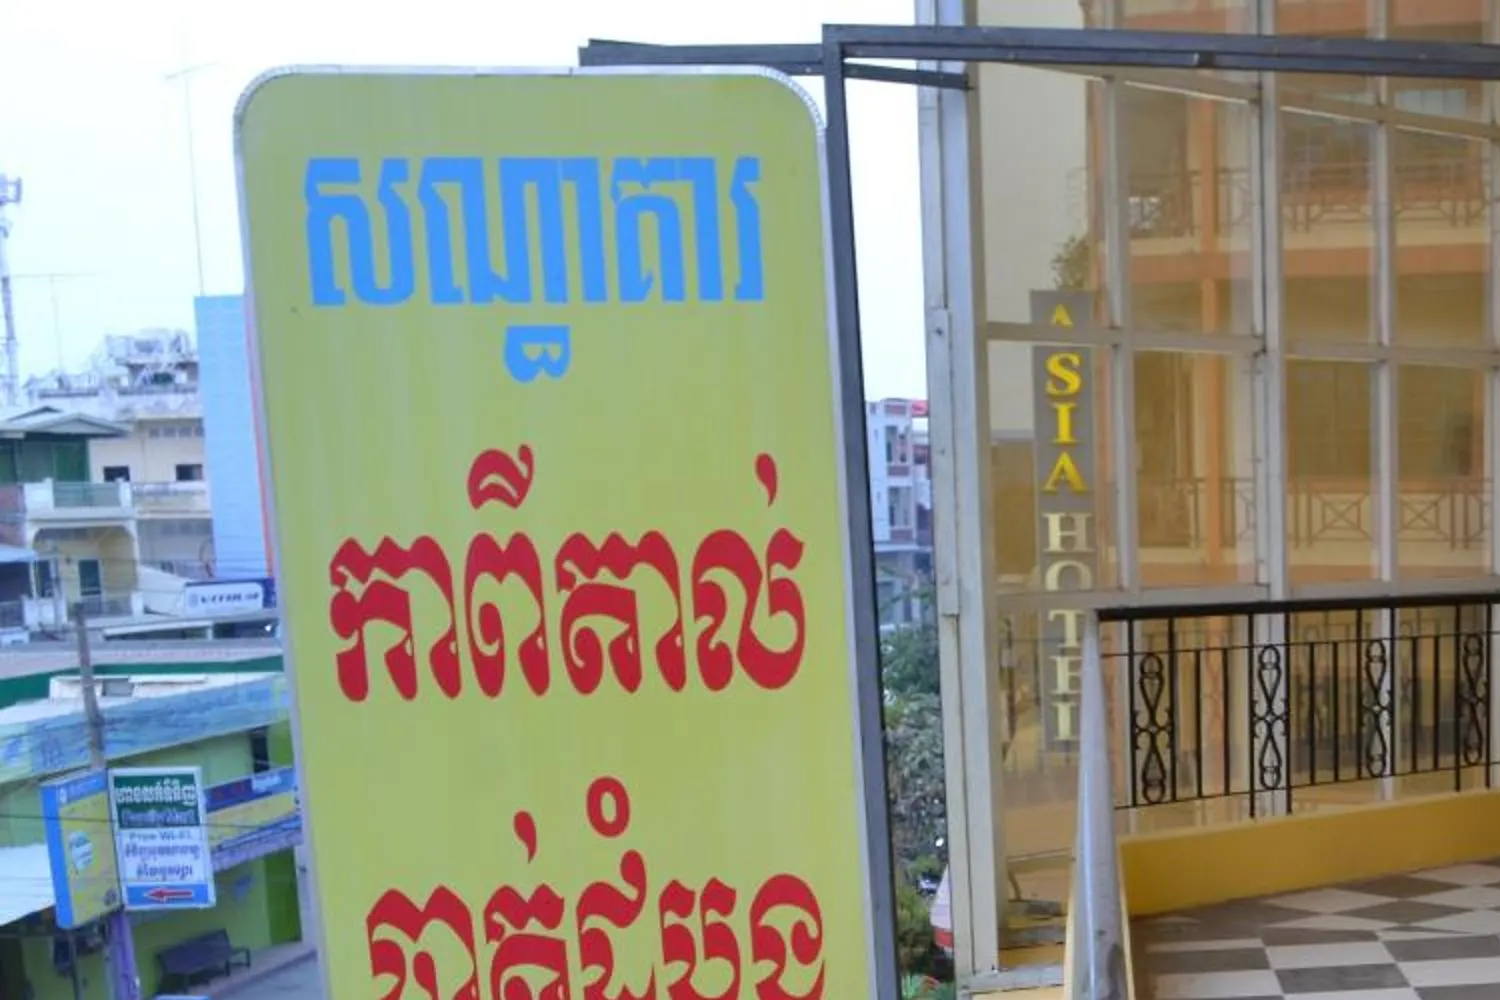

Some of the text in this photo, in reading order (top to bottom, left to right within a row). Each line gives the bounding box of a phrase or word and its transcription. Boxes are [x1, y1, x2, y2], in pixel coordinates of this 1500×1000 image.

[304, 155, 765, 384] សណ្ឋាគារ
[1042, 303, 1090, 495] ASIA
